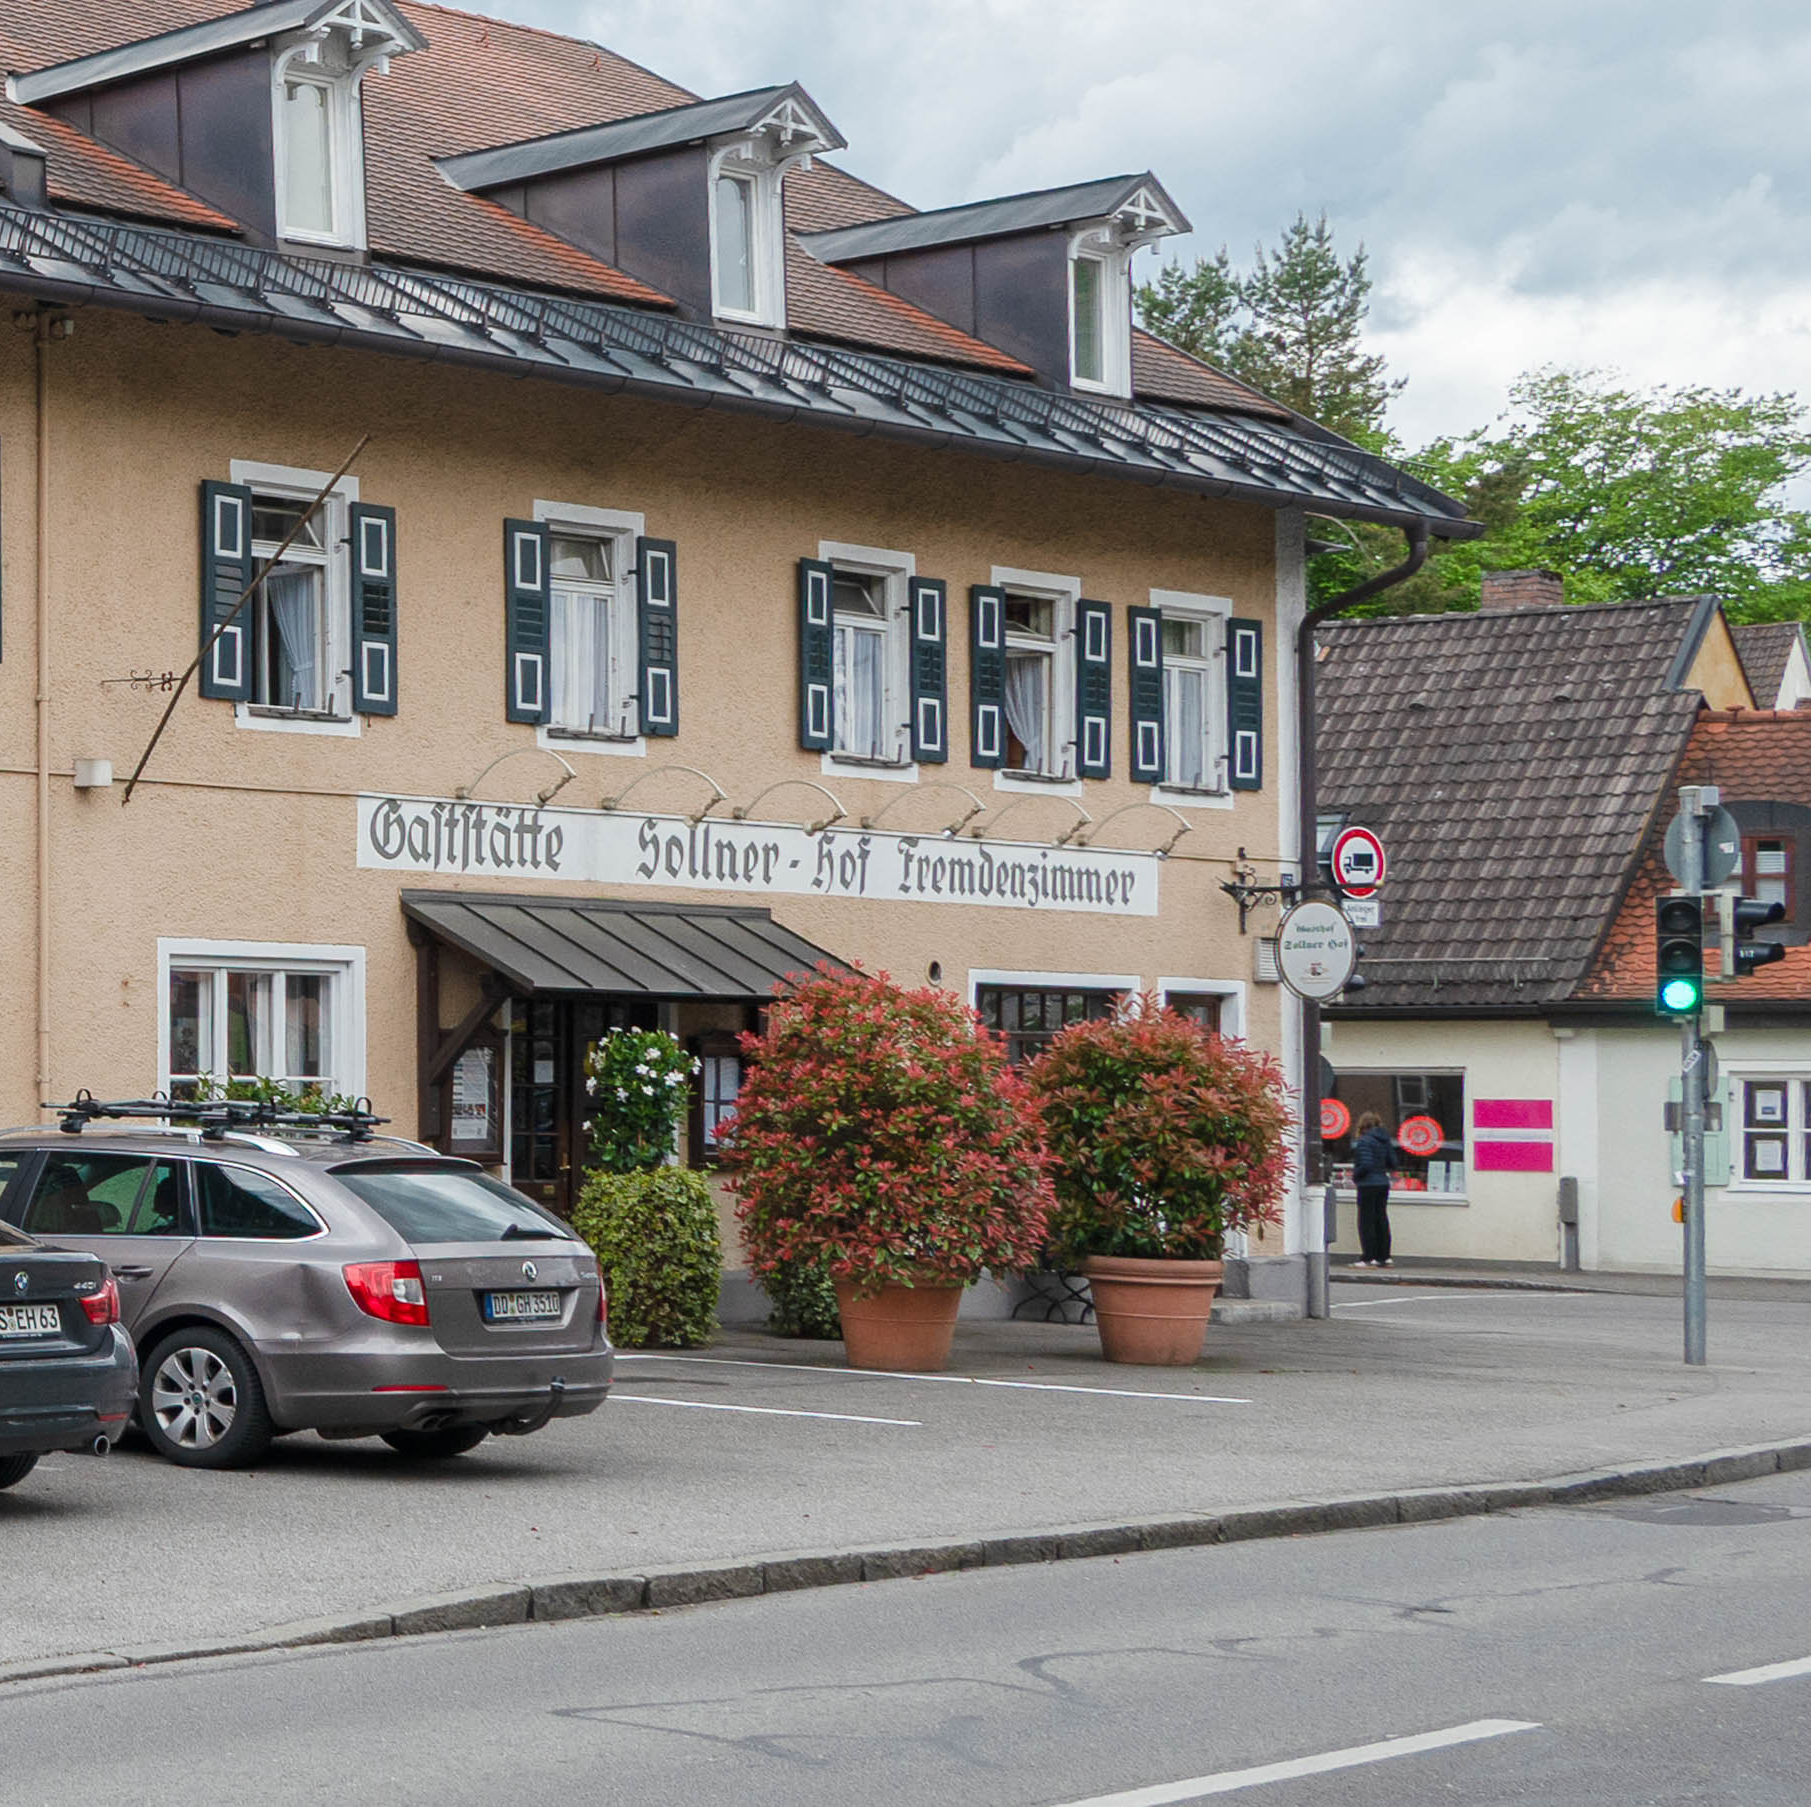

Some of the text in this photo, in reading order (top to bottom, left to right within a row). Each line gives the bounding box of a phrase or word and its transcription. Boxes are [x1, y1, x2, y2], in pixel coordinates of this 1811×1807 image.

[637, 818, 781, 883] Sollner
[811, 832, 872, 895] Hof
[898, 836, 1136, 907] Fremdenzimmer
[494, 1294, 559, 1314] DD GH 3510
[15, 1308, 35, 1329] EH
[39, 1307, 58, 1328] 63
